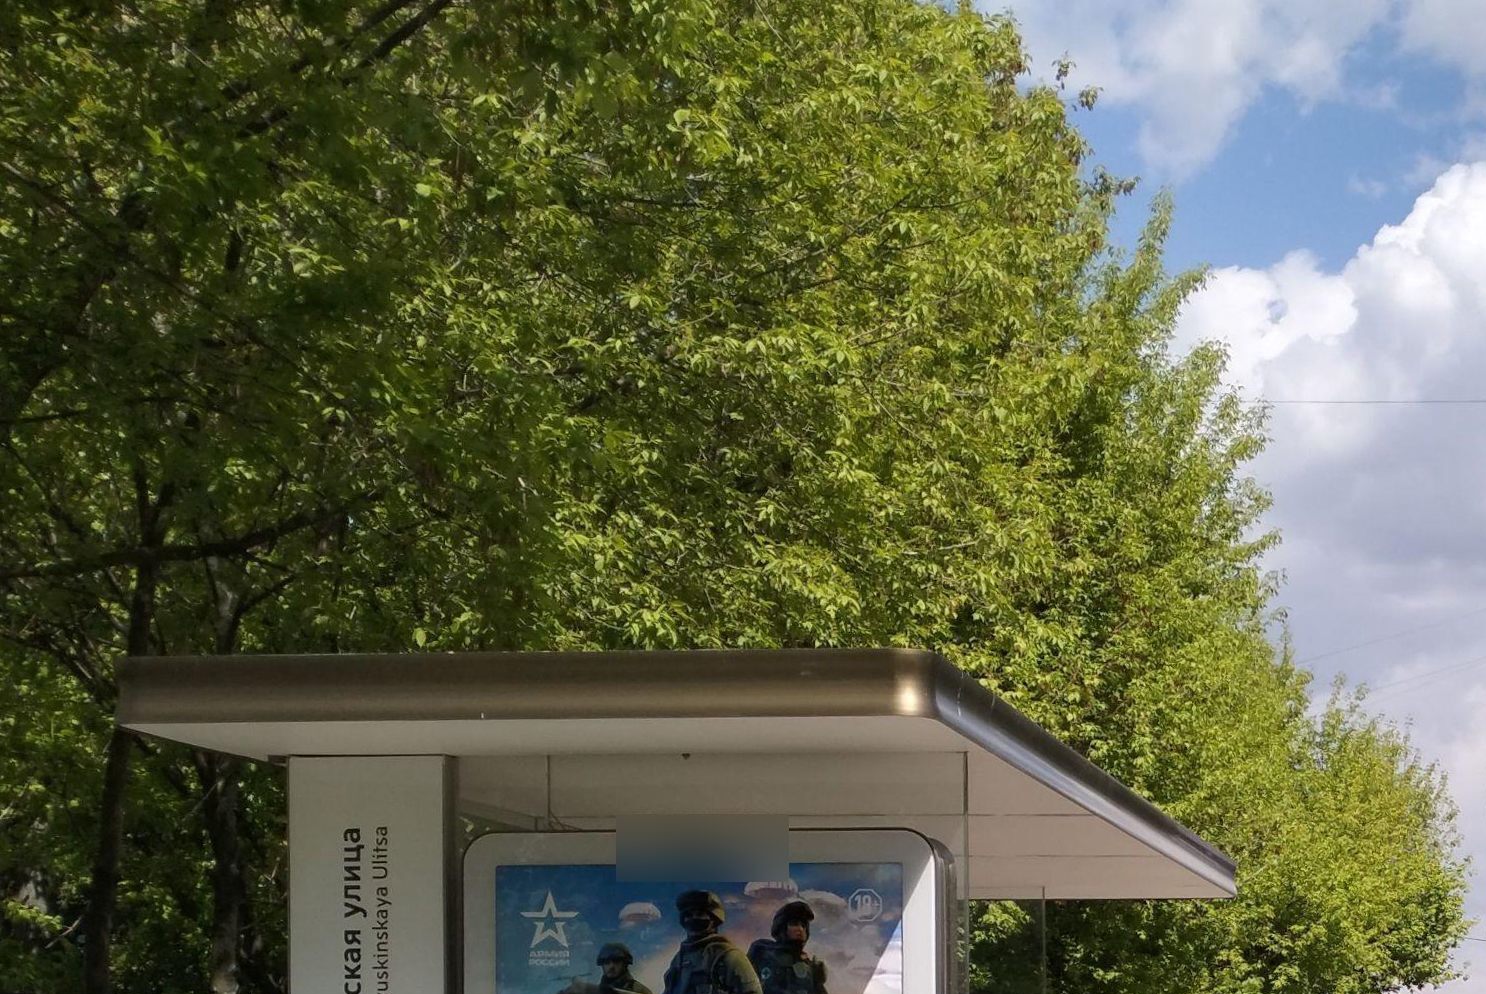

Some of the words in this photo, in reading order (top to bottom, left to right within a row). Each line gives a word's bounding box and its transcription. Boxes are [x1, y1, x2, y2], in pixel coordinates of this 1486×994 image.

[341, 827, 368, 918] улица
[372, 826, 389, 880] Ulitsa
[528, 958, 571, 967] РОССИИ
